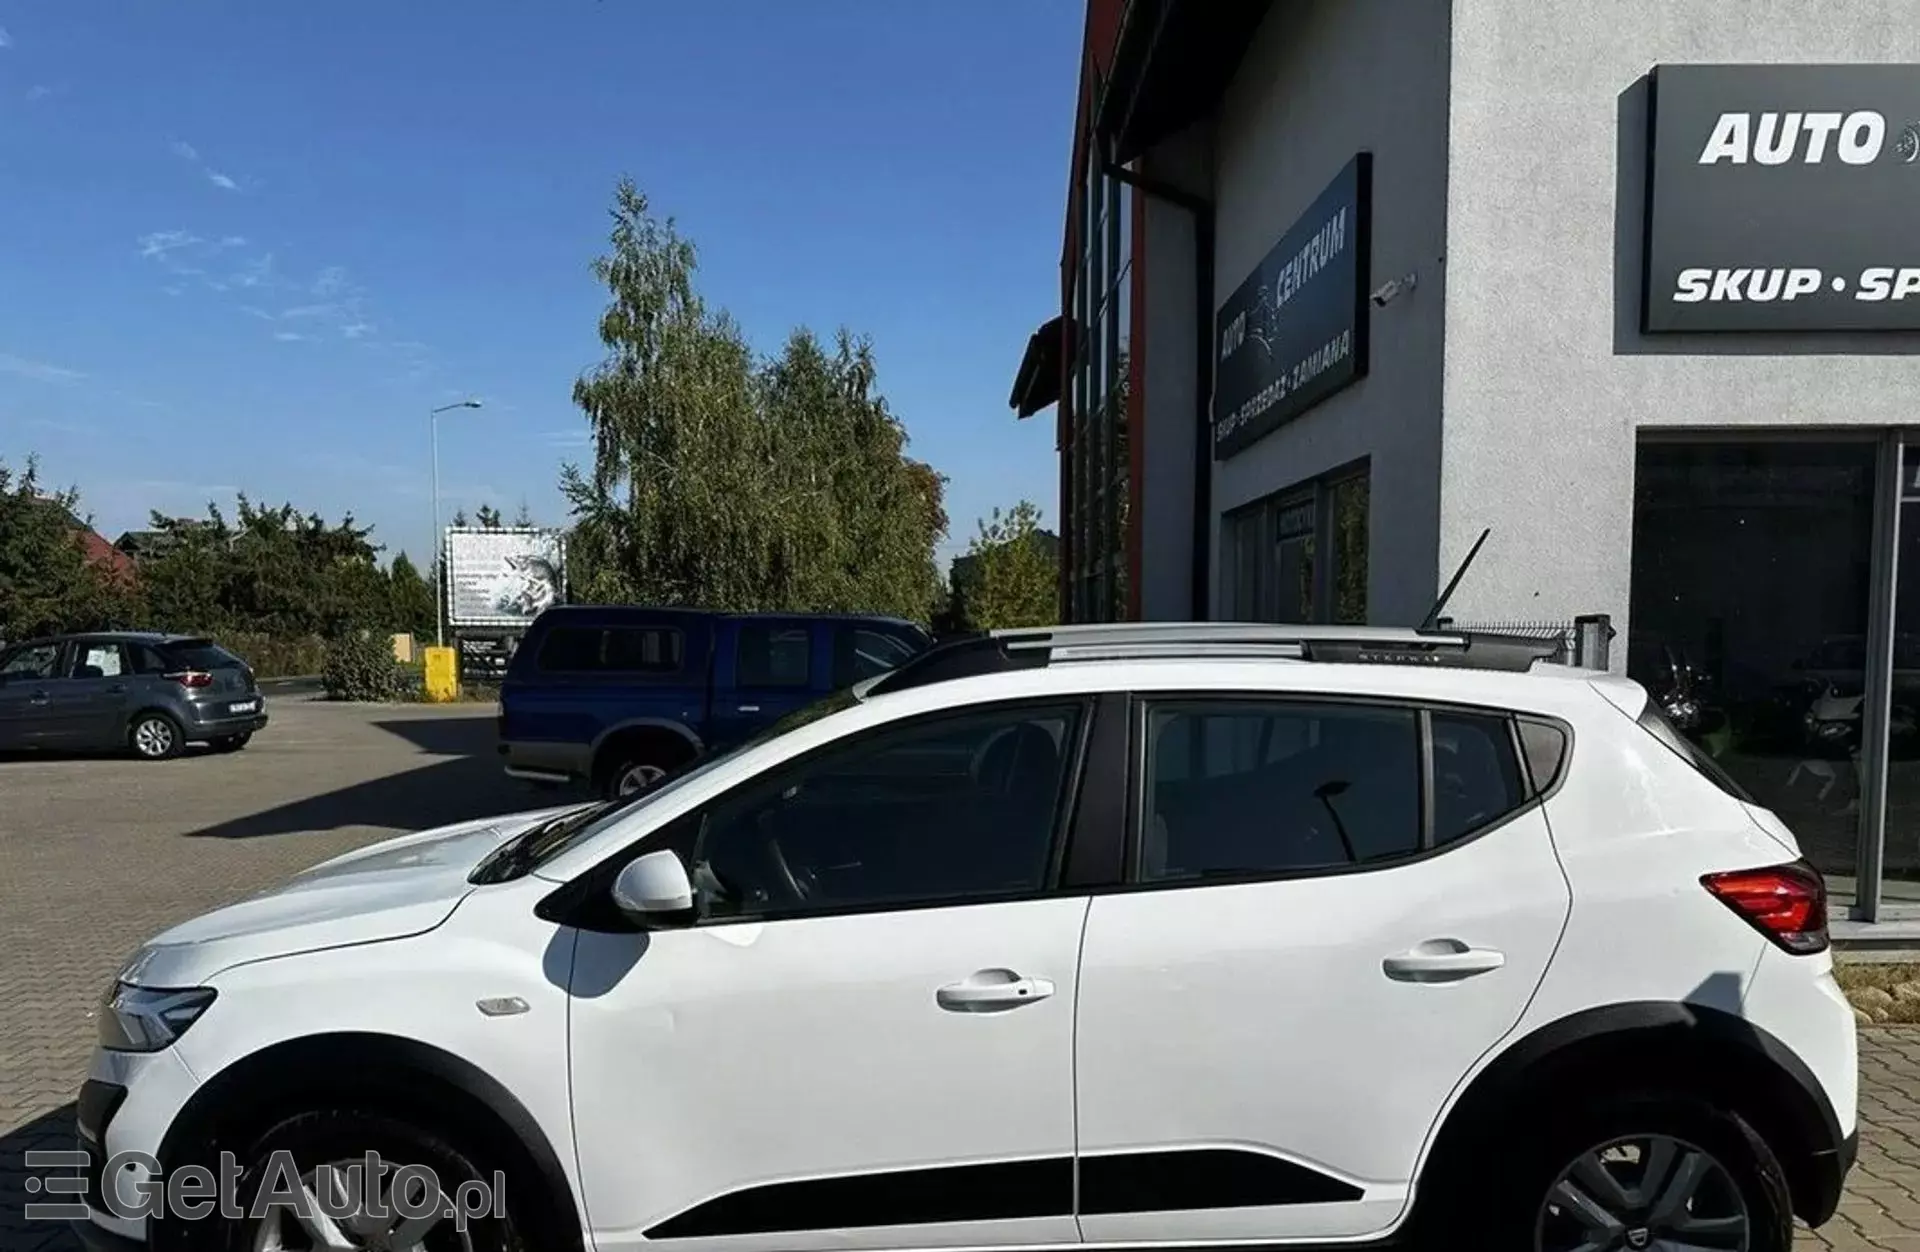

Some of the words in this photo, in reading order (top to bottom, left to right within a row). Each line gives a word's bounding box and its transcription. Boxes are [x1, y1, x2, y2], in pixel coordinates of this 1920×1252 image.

[1698, 111, 1886, 165] AUTO
[1276, 206, 1347, 308] CENTRUM
[1673, 268, 1822, 301] SKUP
[1293, 330, 1349, 390] ZAMIANA
